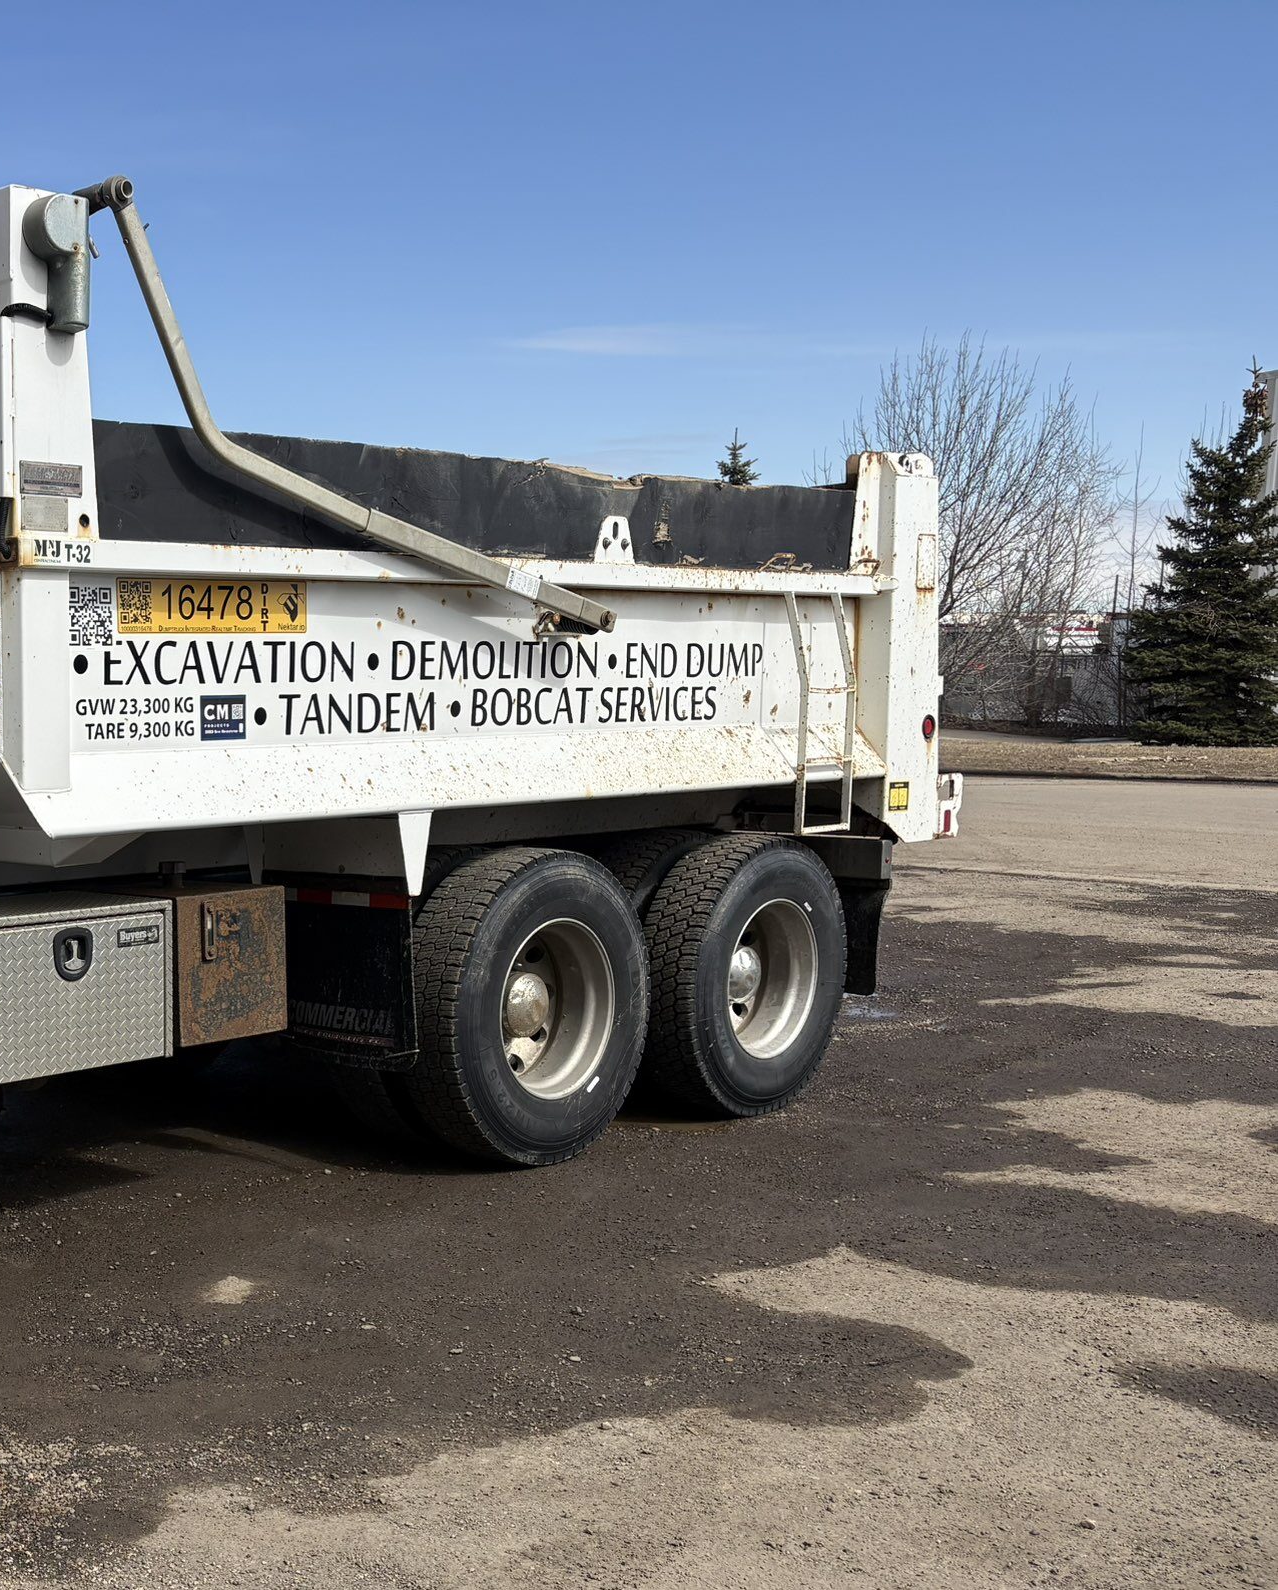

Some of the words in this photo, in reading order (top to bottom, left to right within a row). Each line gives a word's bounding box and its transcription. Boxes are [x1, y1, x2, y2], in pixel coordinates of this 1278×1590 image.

[65, 544, 91, 563] T-32
[161, 583, 254, 621] 16478
[103, 640, 354, 686] EXCAVATION
[390, 640, 598, 681] DEMOLITION
[625, 643, 677, 679] END
[686, 643, 763, 678] DUMP
[75, 699, 117, 716] GVW
[119, 698, 170, 717] 23,300
[174, 697, 194, 714] KG
[204, 704, 229, 720] CM
[278, 692, 436, 736] TANDEM
[470, 687, 594, 727] BOBCAT
[598, 686, 717, 724] SERVICES
[85, 723, 125, 740] TARE
[129, 721, 171, 741] 9,300
[174, 720, 195, 738] KG
